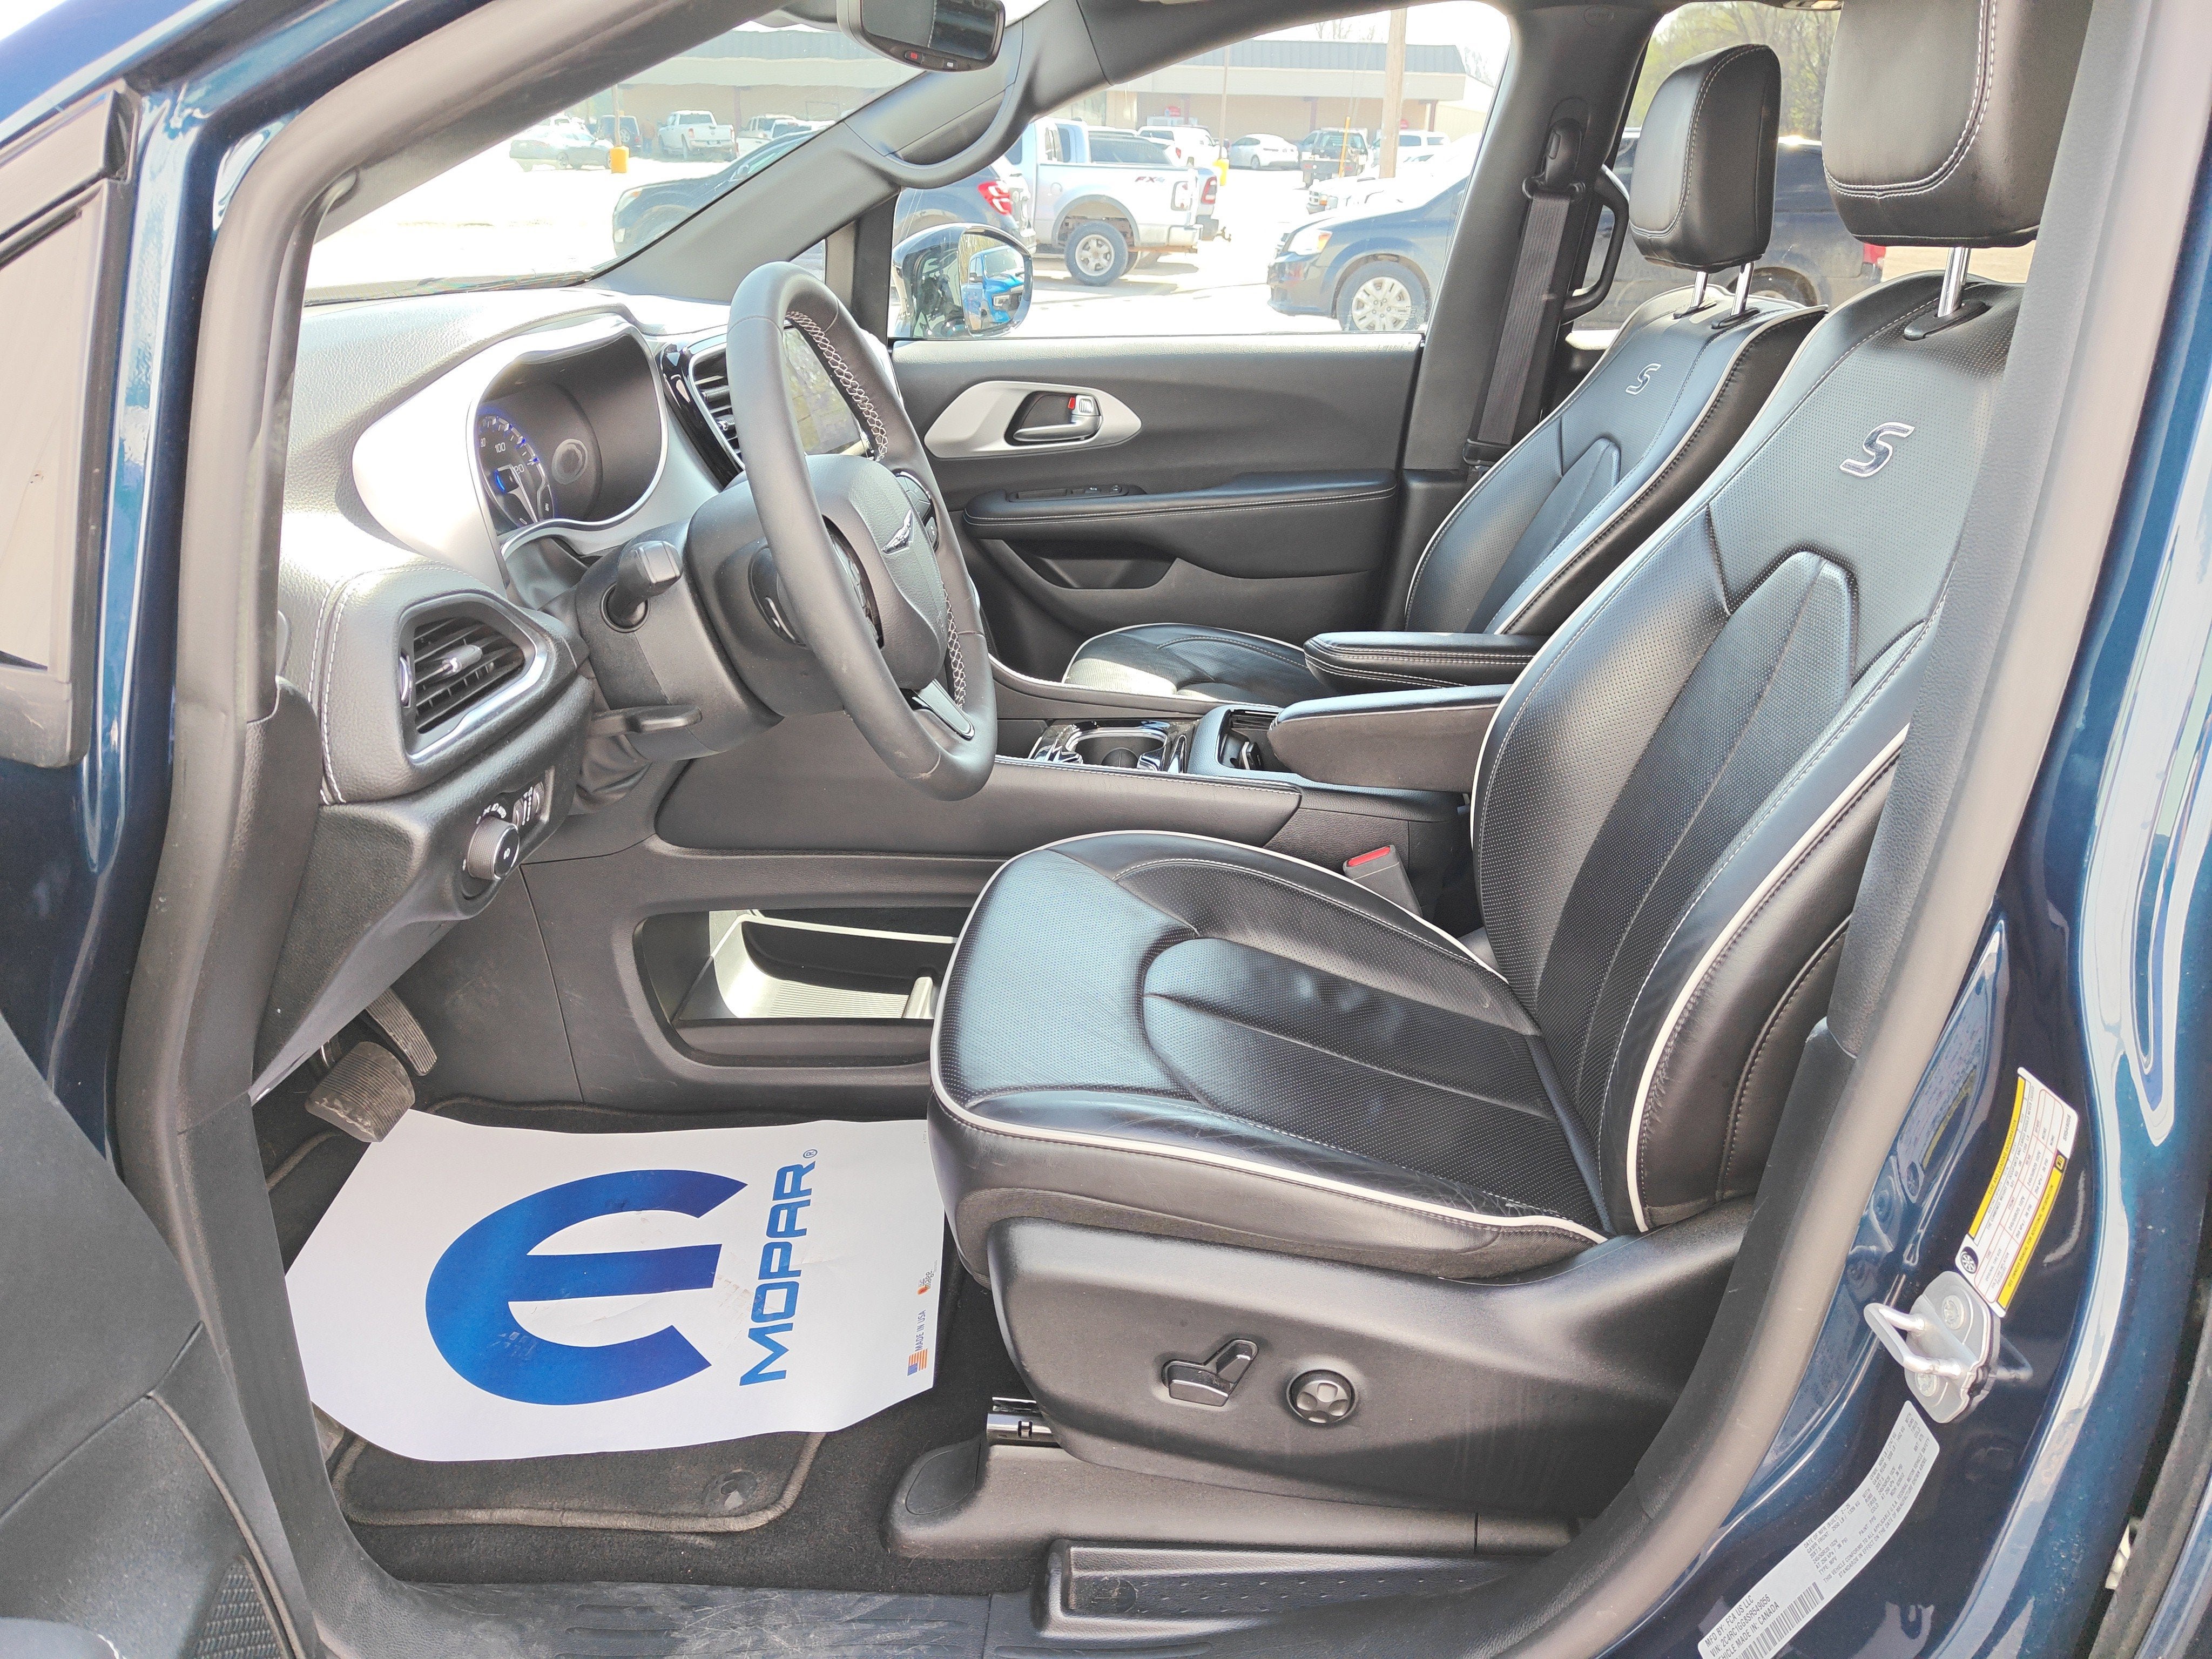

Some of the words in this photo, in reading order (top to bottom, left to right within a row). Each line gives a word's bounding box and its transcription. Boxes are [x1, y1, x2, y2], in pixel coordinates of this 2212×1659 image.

[495, 442, 505, 453] 100
[1839, 422, 1915, 477] S
[916, 1324, 925, 1332] IN
[917, 1310, 926, 1324] USA
[915, 1332, 924, 1351] MADE
[1803, 1537, 1814, 1548] DATE
[1831, 1560, 1845, 1575] VEHICLE
[1845, 1542, 1863, 1562] CONFORMS
[1873, 1510, 1891, 1533] APPLICABLE
[1838, 1556, 1859, 1578] STANDARDS
[1862, 1539, 1874, 1554] EFFECT
[1873, 1533, 1880, 1541] ON
[1884, 1517, 1893, 1528] DATE
[1705, 1633, 1717, 1648] MFD
[1717, 1624, 1727, 1636] BY:
[1726, 1613, 1737, 1627] FCA
[1735, 1604, 1744, 1616] US
[1742, 1595, 1754, 1609] LLC
[1710, 1644, 1723, 1657] VIN:
[1721, 1594, 1770, 1648] 2C4RC1GG8SR549056
[1735, 1629, 1751, 1648] MADE
[1750, 1622, 1759, 1634] IN:
[1757, 1601, 1780, 1625] CANADA
